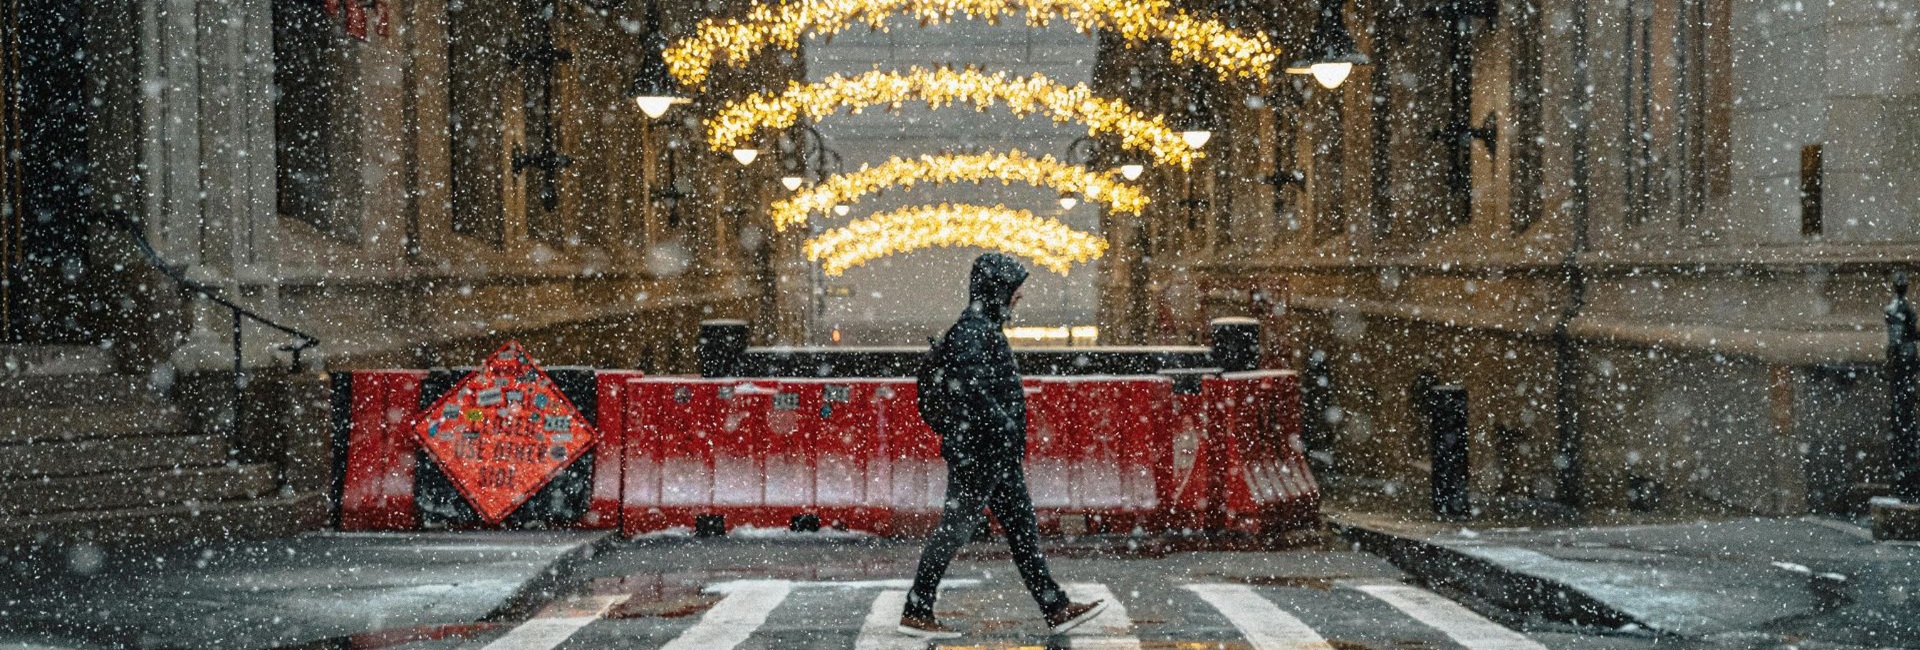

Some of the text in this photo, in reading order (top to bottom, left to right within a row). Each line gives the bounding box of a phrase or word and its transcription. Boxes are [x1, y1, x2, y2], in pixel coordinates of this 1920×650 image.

[453, 439, 485, 462] USE
[492, 439, 549, 464] OTHER
[477, 465, 517, 490] SIDE
